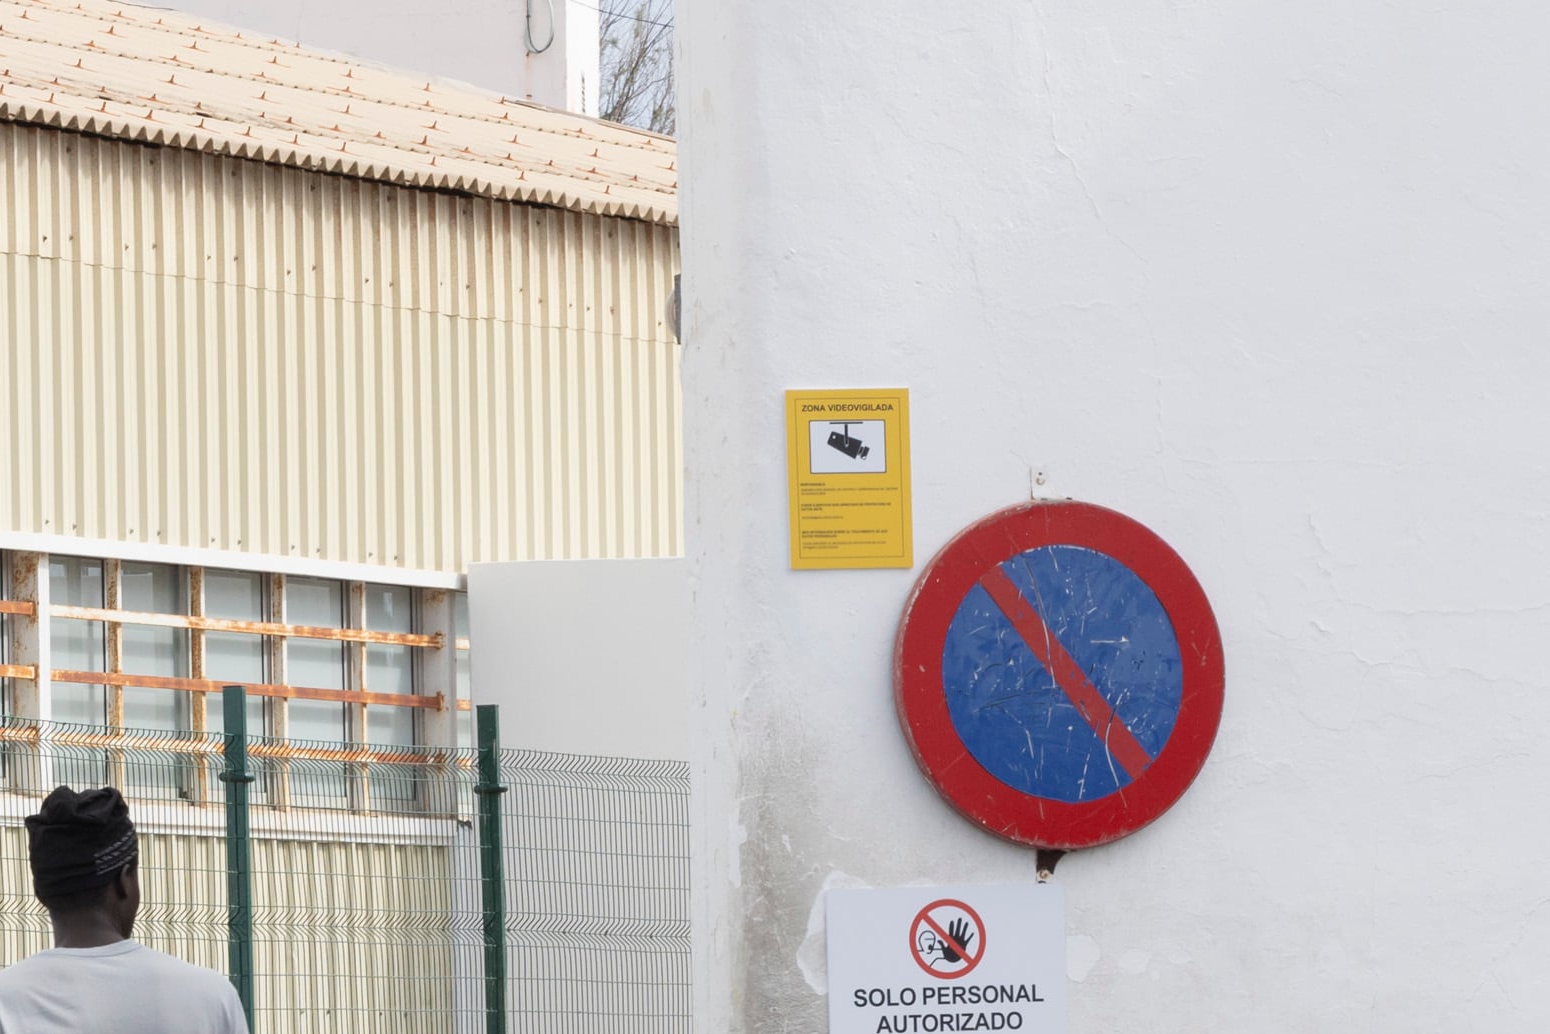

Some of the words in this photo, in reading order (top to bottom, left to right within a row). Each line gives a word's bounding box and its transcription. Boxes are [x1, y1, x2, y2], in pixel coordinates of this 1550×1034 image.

[801, 404, 826, 412] ZONA
[827, 403, 894, 412] VIDEOVIGILADA
[854, 987, 916, 1008] SOLO
[922, 984, 1044, 1005] PERSONAL
[876, 1011, 1023, 1034] AUTORIZADO
